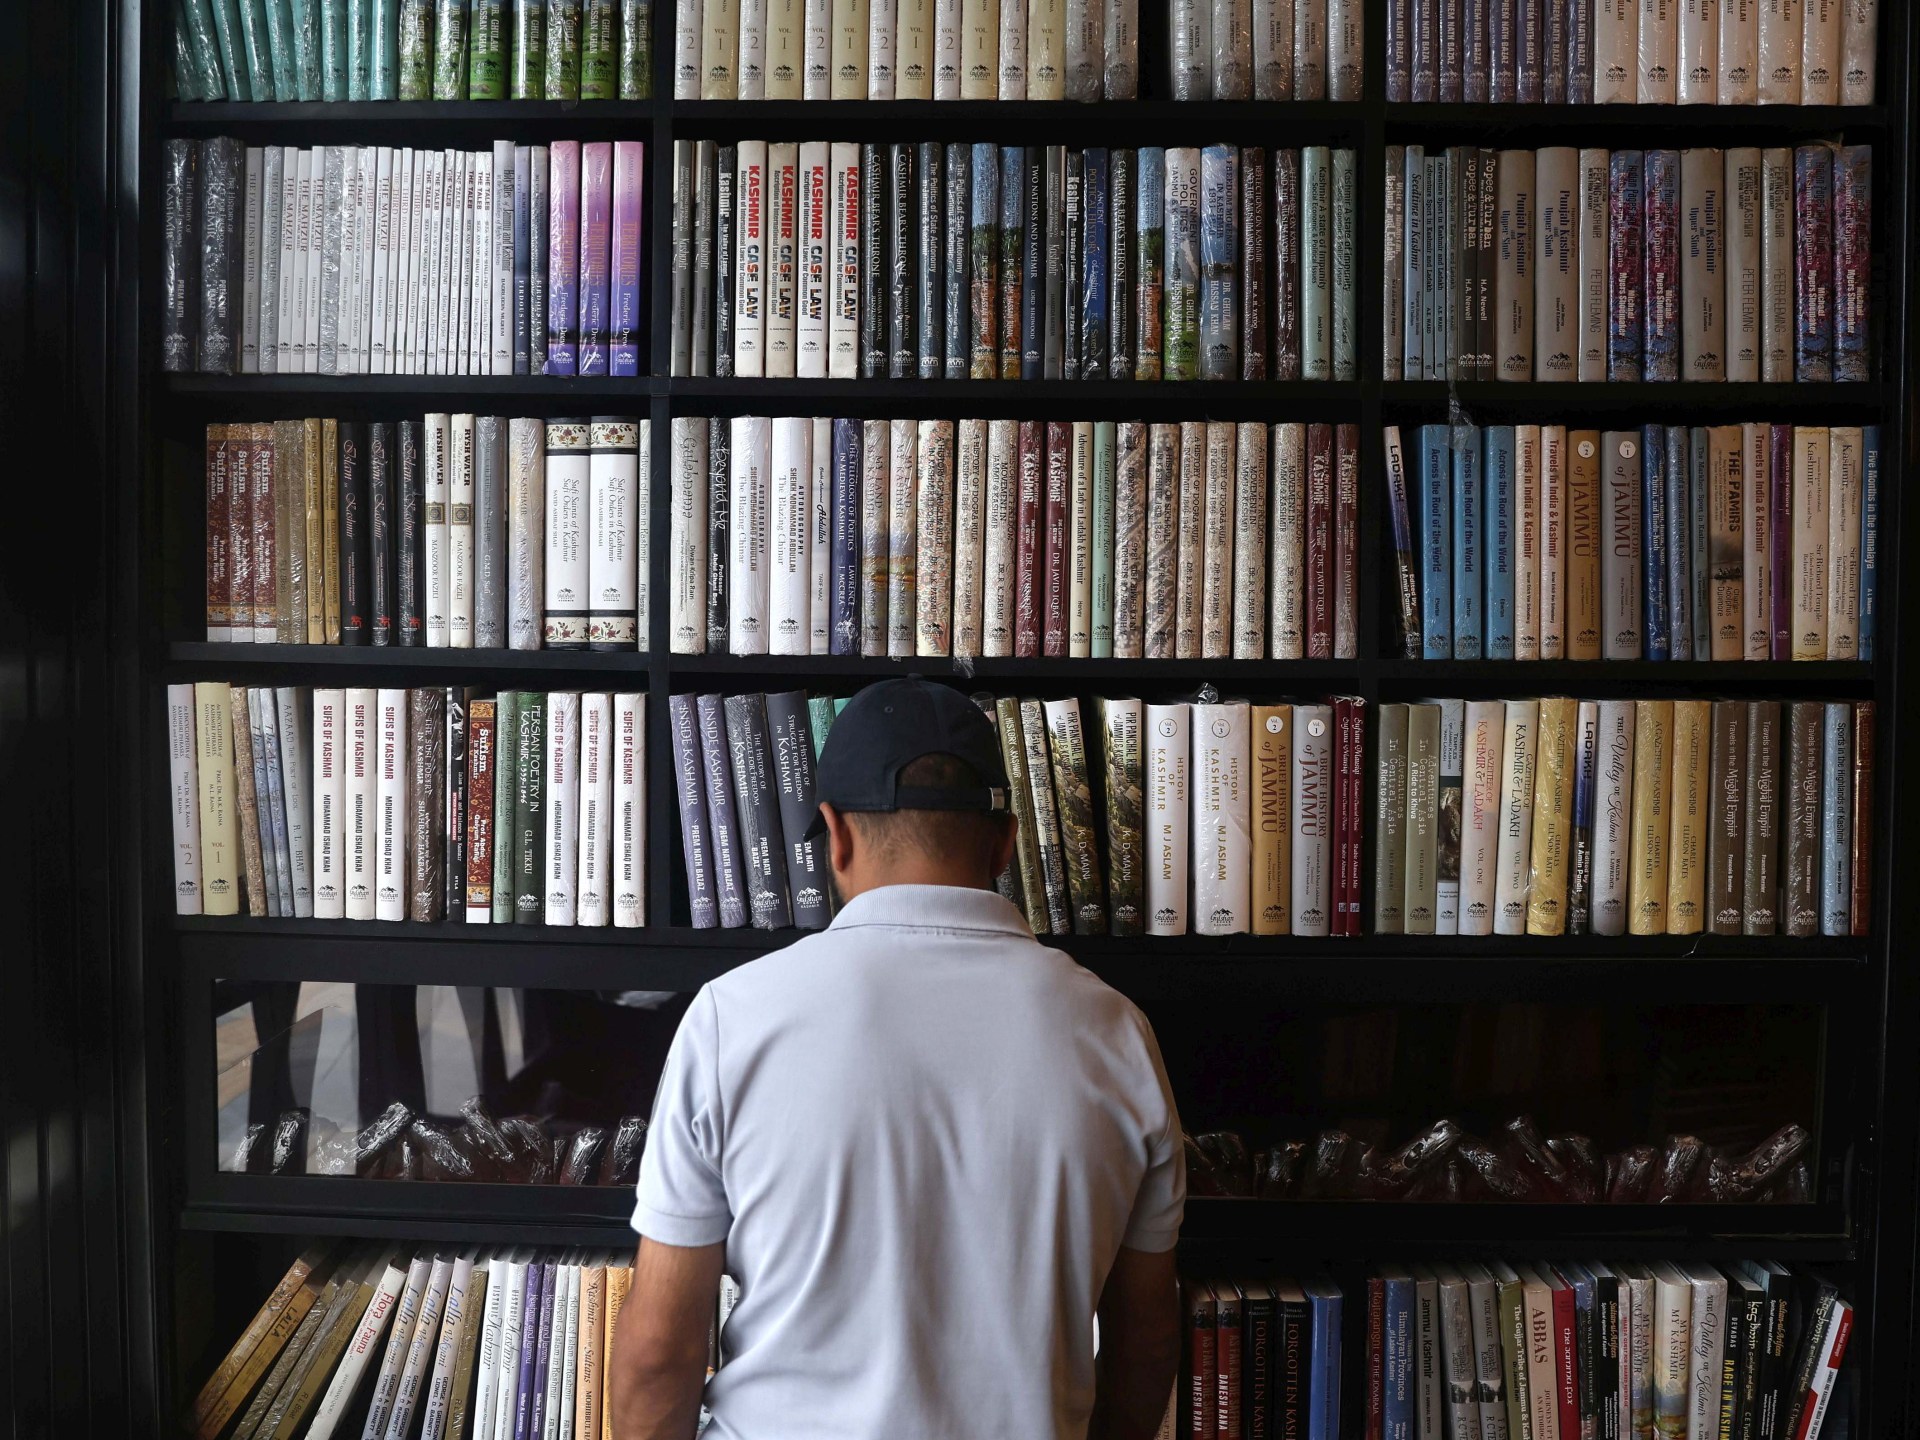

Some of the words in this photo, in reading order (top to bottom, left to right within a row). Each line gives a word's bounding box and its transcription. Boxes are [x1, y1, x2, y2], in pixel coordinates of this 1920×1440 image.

[491, 19, 499, 51] GHULAM
[718, 38, 722, 50] 1
[816, 37, 824, 49] 2
[1578, 23, 1586, 42] NATH
[872, 155, 880, 200] CASHMIR
[1318, 166, 1326, 203] Kashmir
[1485, 159, 1496, 192] Topee
[846, 167, 857, 239] KASHMIR
[1436, 197, 1444, 214] Sport
[1485, 194, 1494, 202] &
[872, 202, 880, 232] BEAR'S
[1318, 214, 1326, 237] state
[1483, 204, 1494, 248] Turban
[620, 222, 637, 286] TERRITORIES
[872, 236, 880, 277] THRONE
[1318, 240, 1326, 248] of
[845, 246, 856, 283] CASE
[1317, 251, 1326, 289] Impunity
[1743, 268, 1754, 294] PETER
[1808, 270, 1816, 292] Myers
[622, 292, 631, 324] Frederic
[845, 290, 856, 320] LAW
[1742, 298, 1754, 332] FLEMING
[1808, 294, 1816, 334] Shoemaker
[622, 328, 630, 347] Drew
[1078, 433, 1087, 470] Adventure
[1498, 450, 1508, 478] Across
[1729, 450, 1740, 476] THE
[1868, 450, 1878, 468] Five
[217, 451, 226, 493] Sufism
[616, 478, 625, 494] Sufi
[778, 476, 787, 492] The
[1867, 470, 1877, 502] Months
[1076, 488, 1086, 504] Lady
[1498, 482, 1508, 495] the
[617, 496, 625, 518] Saints
[777, 497, 787, 531] Blazing
[1498, 498, 1508, 518] Roof
[1730, 481, 1740, 532] PAMIRS
[1867, 515, 1876, 527] the
[616, 520, 625, 529] of
[1077, 516, 1086, 543] Ladakh
[1498, 520, 1508, 528] of
[1498, 531, 1508, 545] the
[617, 530, 625, 561] Kashmir
[778, 534, 786, 566] Chinar
[1498, 547, 1508, 572] World
[1866, 530, 1876, 569] Himalaya
[1076, 554, 1086, 584] Kashmir
[324, 706, 332, 728] SUFIS
[531, 706, 541, 751] PERSIAN
[679, 708, 693, 745] INSIDE
[323, 730, 332, 740] OF
[1513, 724, 1526, 774] KASHMIR
[1836, 723, 1846, 746] Sports
[323, 742, 332, 778] KASHMIR
[1305, 744, 1315, 756] of
[1584, 722, 1594, 779] LADAKH
[1837, 756, 1846, 767] the
[530, 754, 540, 798] POETRY
[682, 749, 698, 806] KASHMIR
[1157, 748, 1166, 810] KASHMIR
[1169, 774, 1175, 786] OF
[1318, 758, 1328, 788] BRIEF
[1512, 777, 1522, 788] &
[1836, 770, 1846, 804] Highlands
[530, 802, 540, 812] IN
[1299, 758, 1318, 837] JAMMU
[1318, 791, 1327, 838] HISTORY
[1510, 789, 1522, 838] LADAKH
[524, 830, 532, 846] G.L.
[692, 825, 702, 846] PREM
[1164, 824, 1172, 834] M
[1837, 816, 1846, 844] Kashmir
[322, 836, 330, 854] ISHAQ
[694, 848, 703, 867] NATH
[524, 849, 532, 874] TIKKU
[1162, 844, 1172, 880] ASLAM
[696, 869, 705, 891] BAZAZ
[372, 1292, 394, 1318] Flora
[446, 1284, 464, 1326] Lalla
[587, 1282, 598, 1326] Kashmir
[1671, 1309, 1679, 1326] MY
[357, 1328, 376, 1354] Fauna
[1397, 1312, 1408, 1357] Himalayan
[1532, 1308, 1548, 1364] ABBAS
[1680, 1320, 1687, 1336] MY
[1730, 1317, 1738, 1348] DEVADAS
[584, 1347, 595, 1383] Sultans
[1286, 1323, 1298, 1404] FORGOTTEN
[1670, 1330, 1678, 1380] KASHMIR
[1398, 1360, 1406, 1401] Provinces
[1722, 1360, 1735, 1386] RAGE
[1219, 1374, 1228, 1406] DANESH
[1722, 1390, 1732, 1401] IN
[1218, 1409, 1228, 1430] RANA
